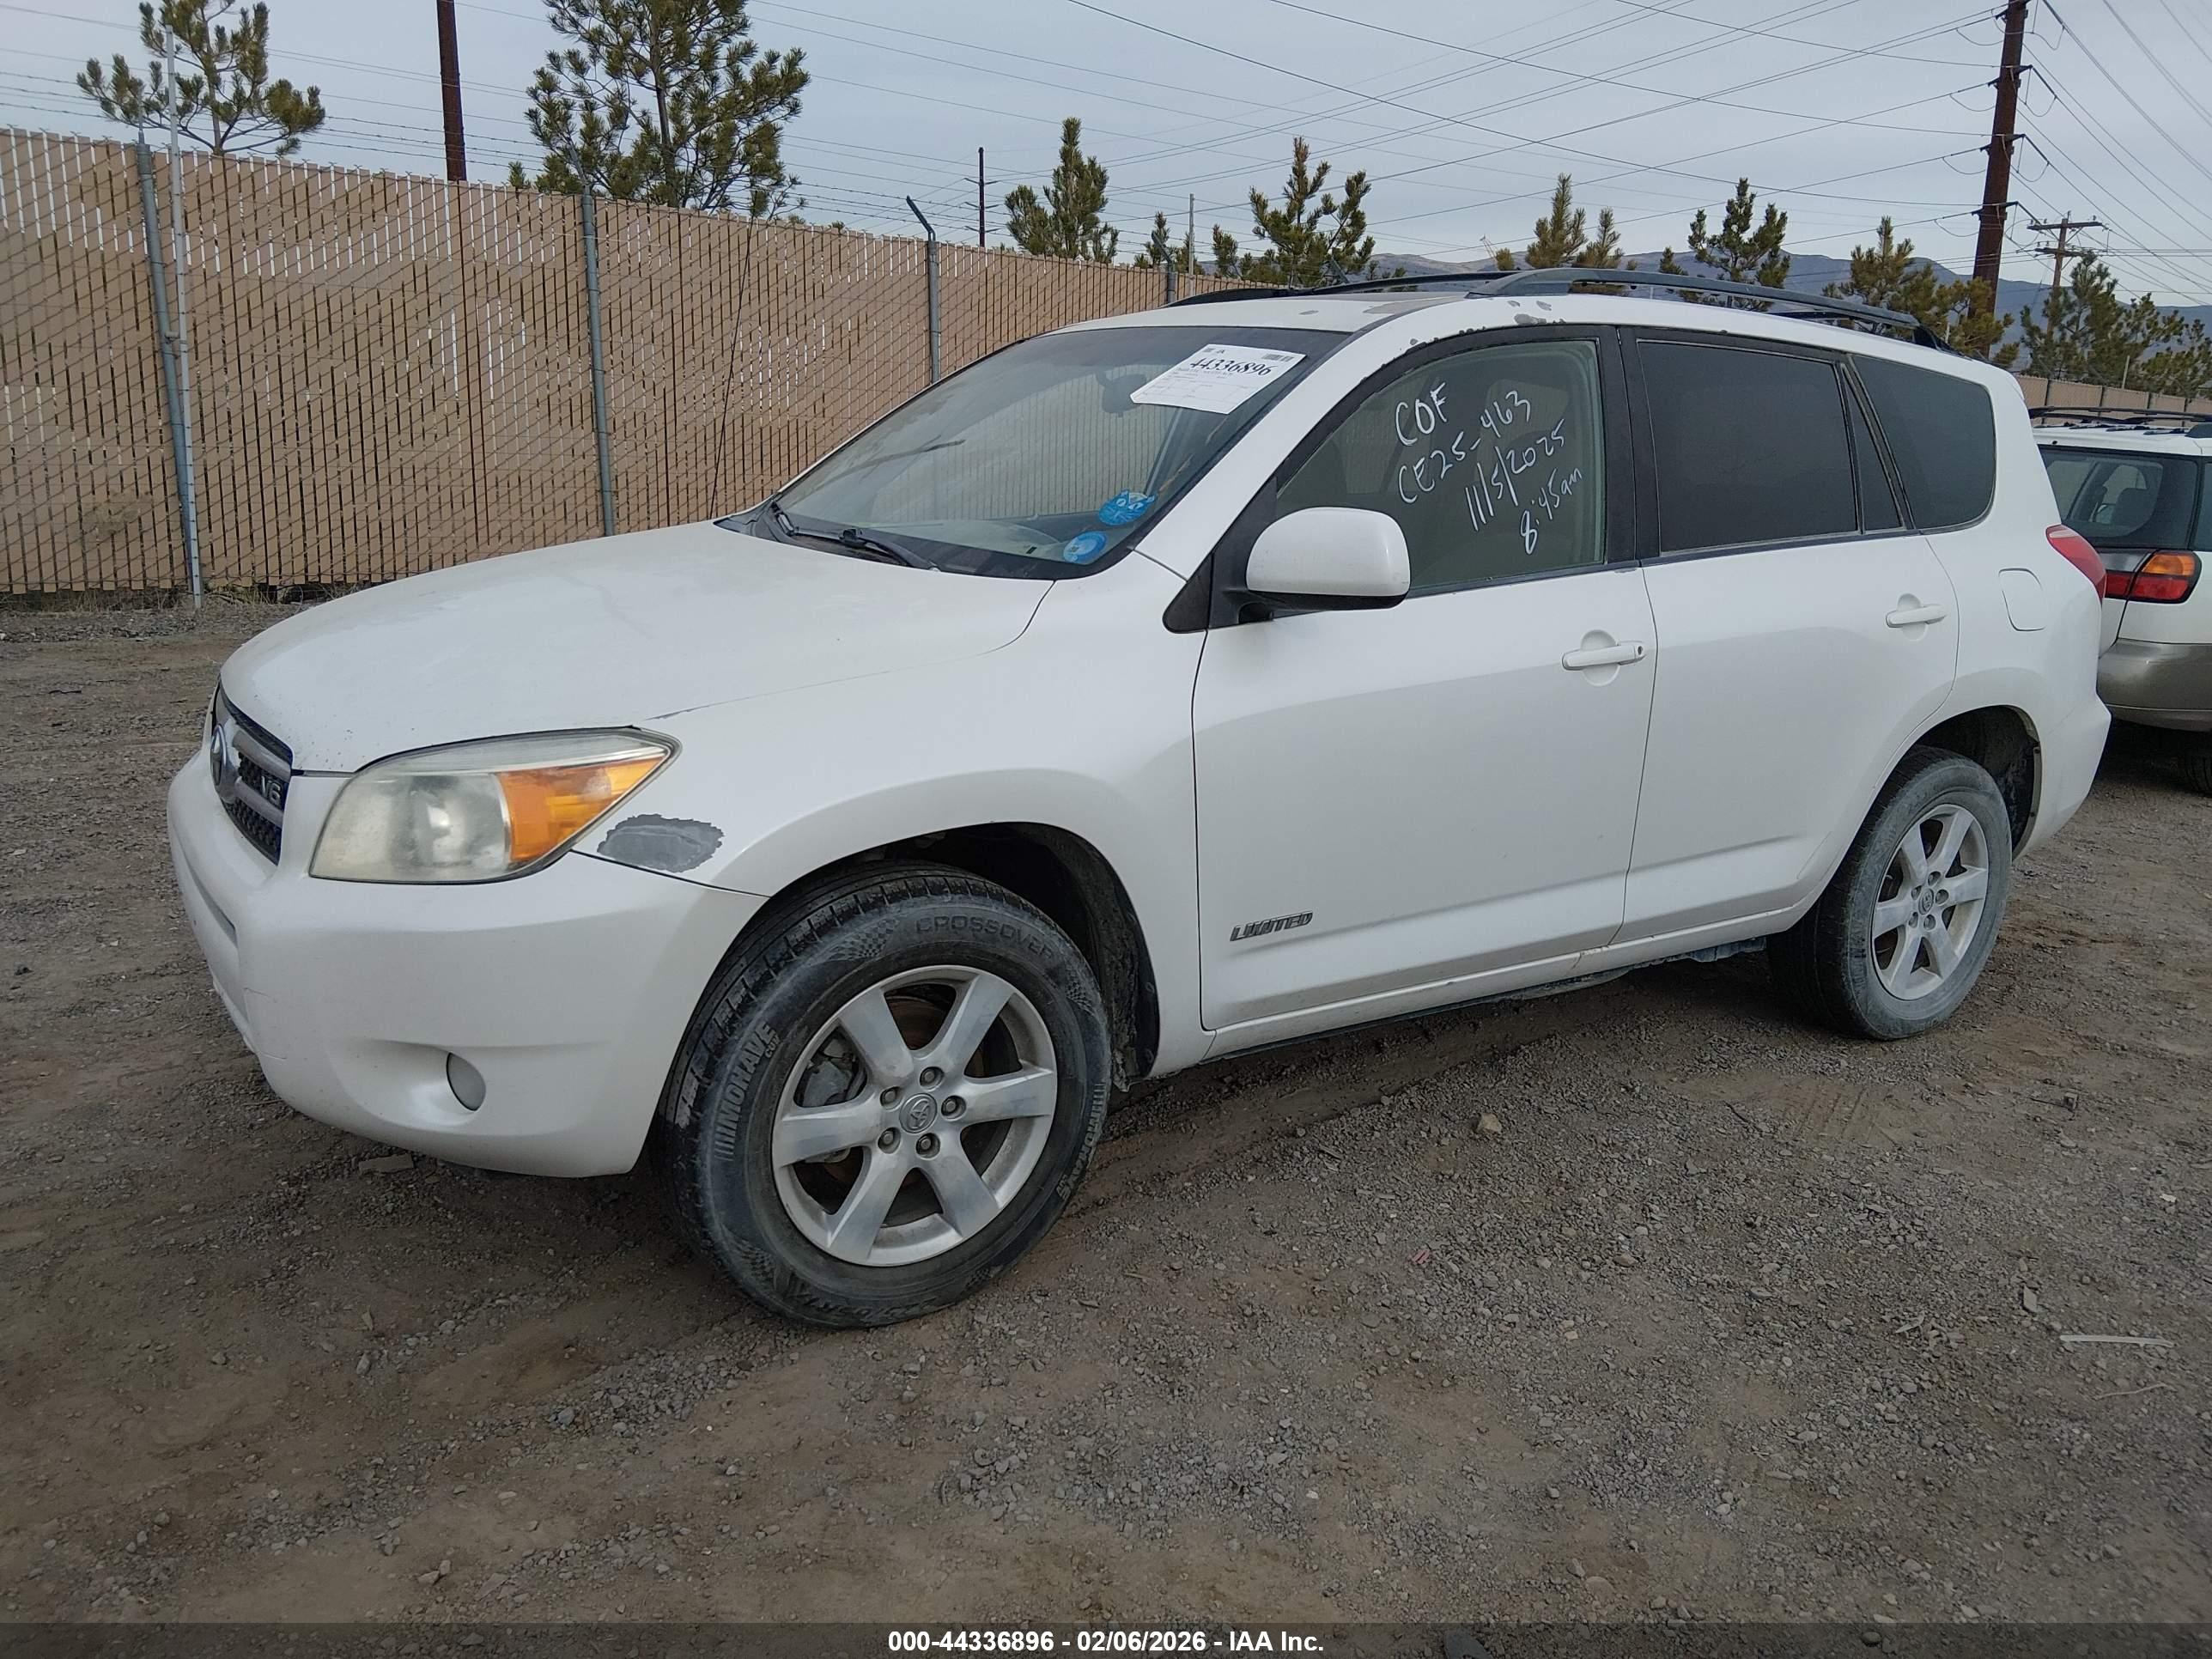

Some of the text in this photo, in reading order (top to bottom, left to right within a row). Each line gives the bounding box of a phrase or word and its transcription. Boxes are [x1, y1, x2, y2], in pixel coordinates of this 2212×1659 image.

[1190, 357, 1278, 376] 44336896
[1395, 382, 1448, 447] COF
[1398, 390, 1531, 504] CE25-463
[1465, 419, 1565, 532] 11/5/2025
[915, 915, 1053, 959] CROSSOVER
[1230, 910, 1314, 942] LIMITED
[715, 1021, 775, 1123] MOHAVE
